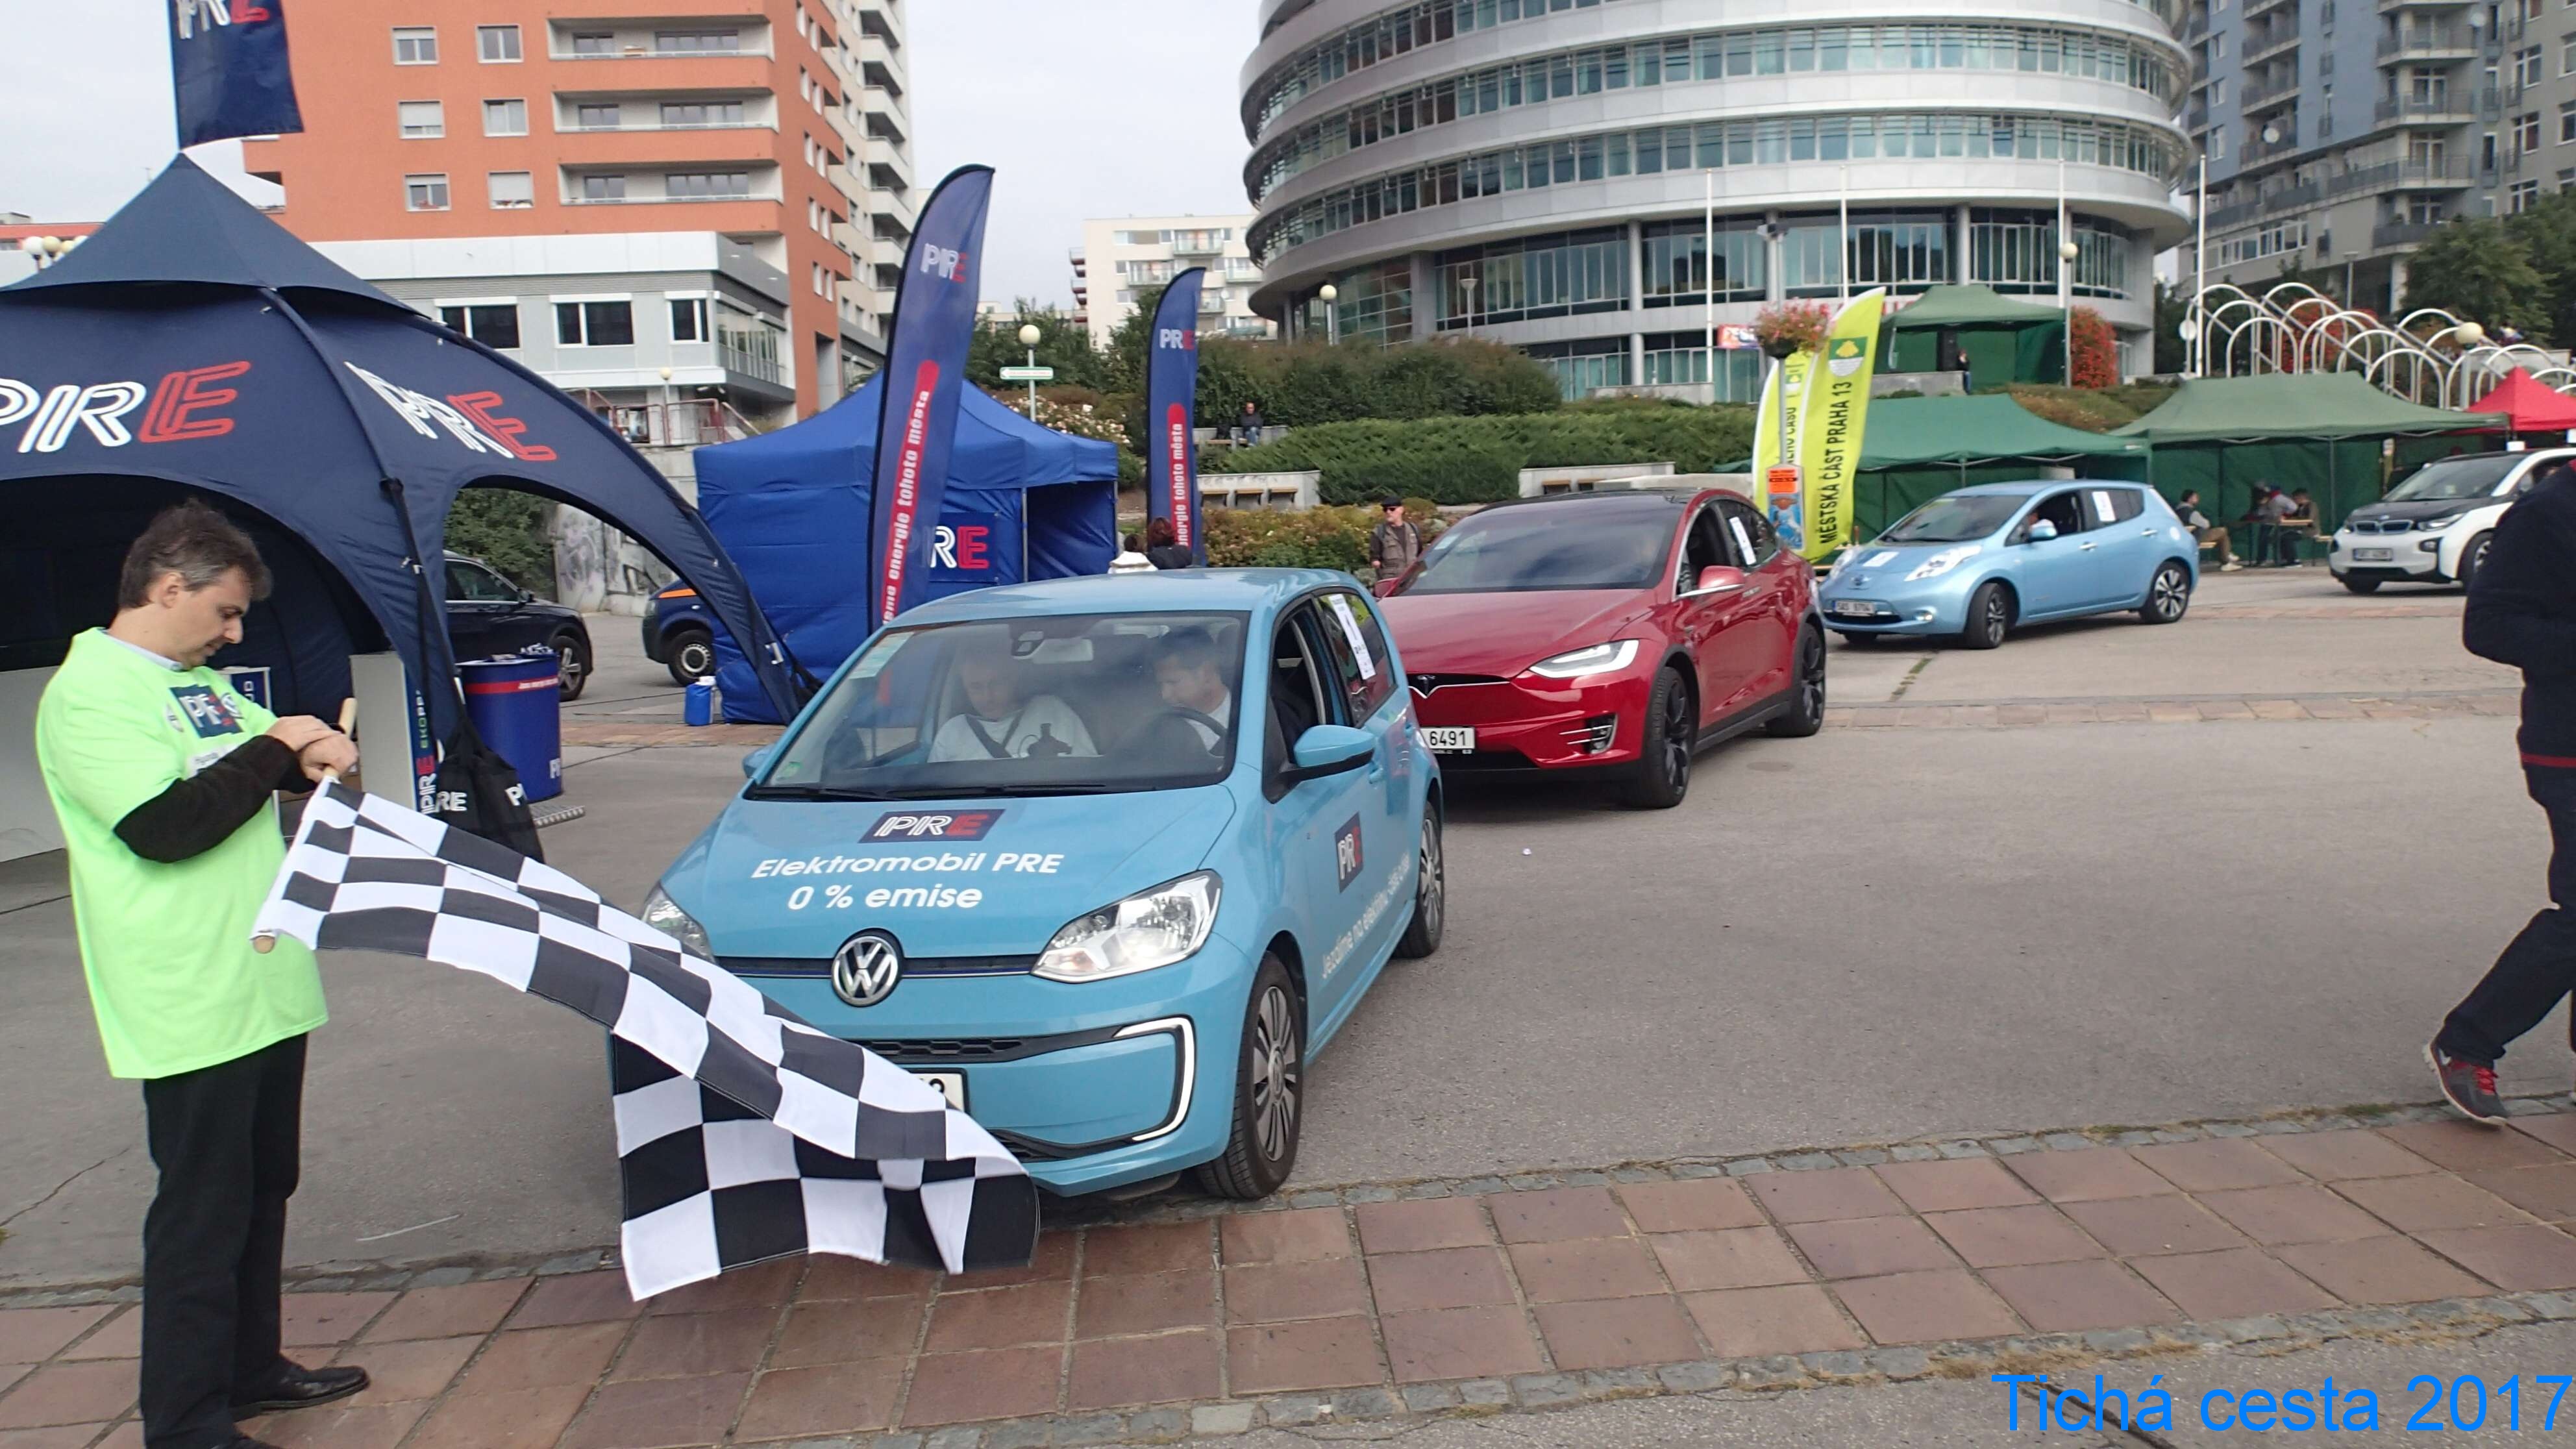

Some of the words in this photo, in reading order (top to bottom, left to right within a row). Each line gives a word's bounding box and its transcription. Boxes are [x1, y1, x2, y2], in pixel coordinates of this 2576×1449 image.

[921, 242, 969, 284] PRE
[1159, 328, 1195, 351] PRE
[1832, 382, 1853, 397] 13
[343, 361, 558, 462] PRE
[1827, 400, 1850, 444] PRAHA
[897, 450, 919, 506] tohoto
[1172, 463, 1186, 501] tohoto
[929, 526, 990, 569] RE
[1430, 730, 1466, 746] 6491
[873, 813, 989, 837] PRE
[750, 852, 986, 878] Elektromobil
[992, 852, 1064, 874] PRE
[787, 886, 813, 910] 0
[824, 884, 853, 909] %
[865, 884, 983, 908] emise
